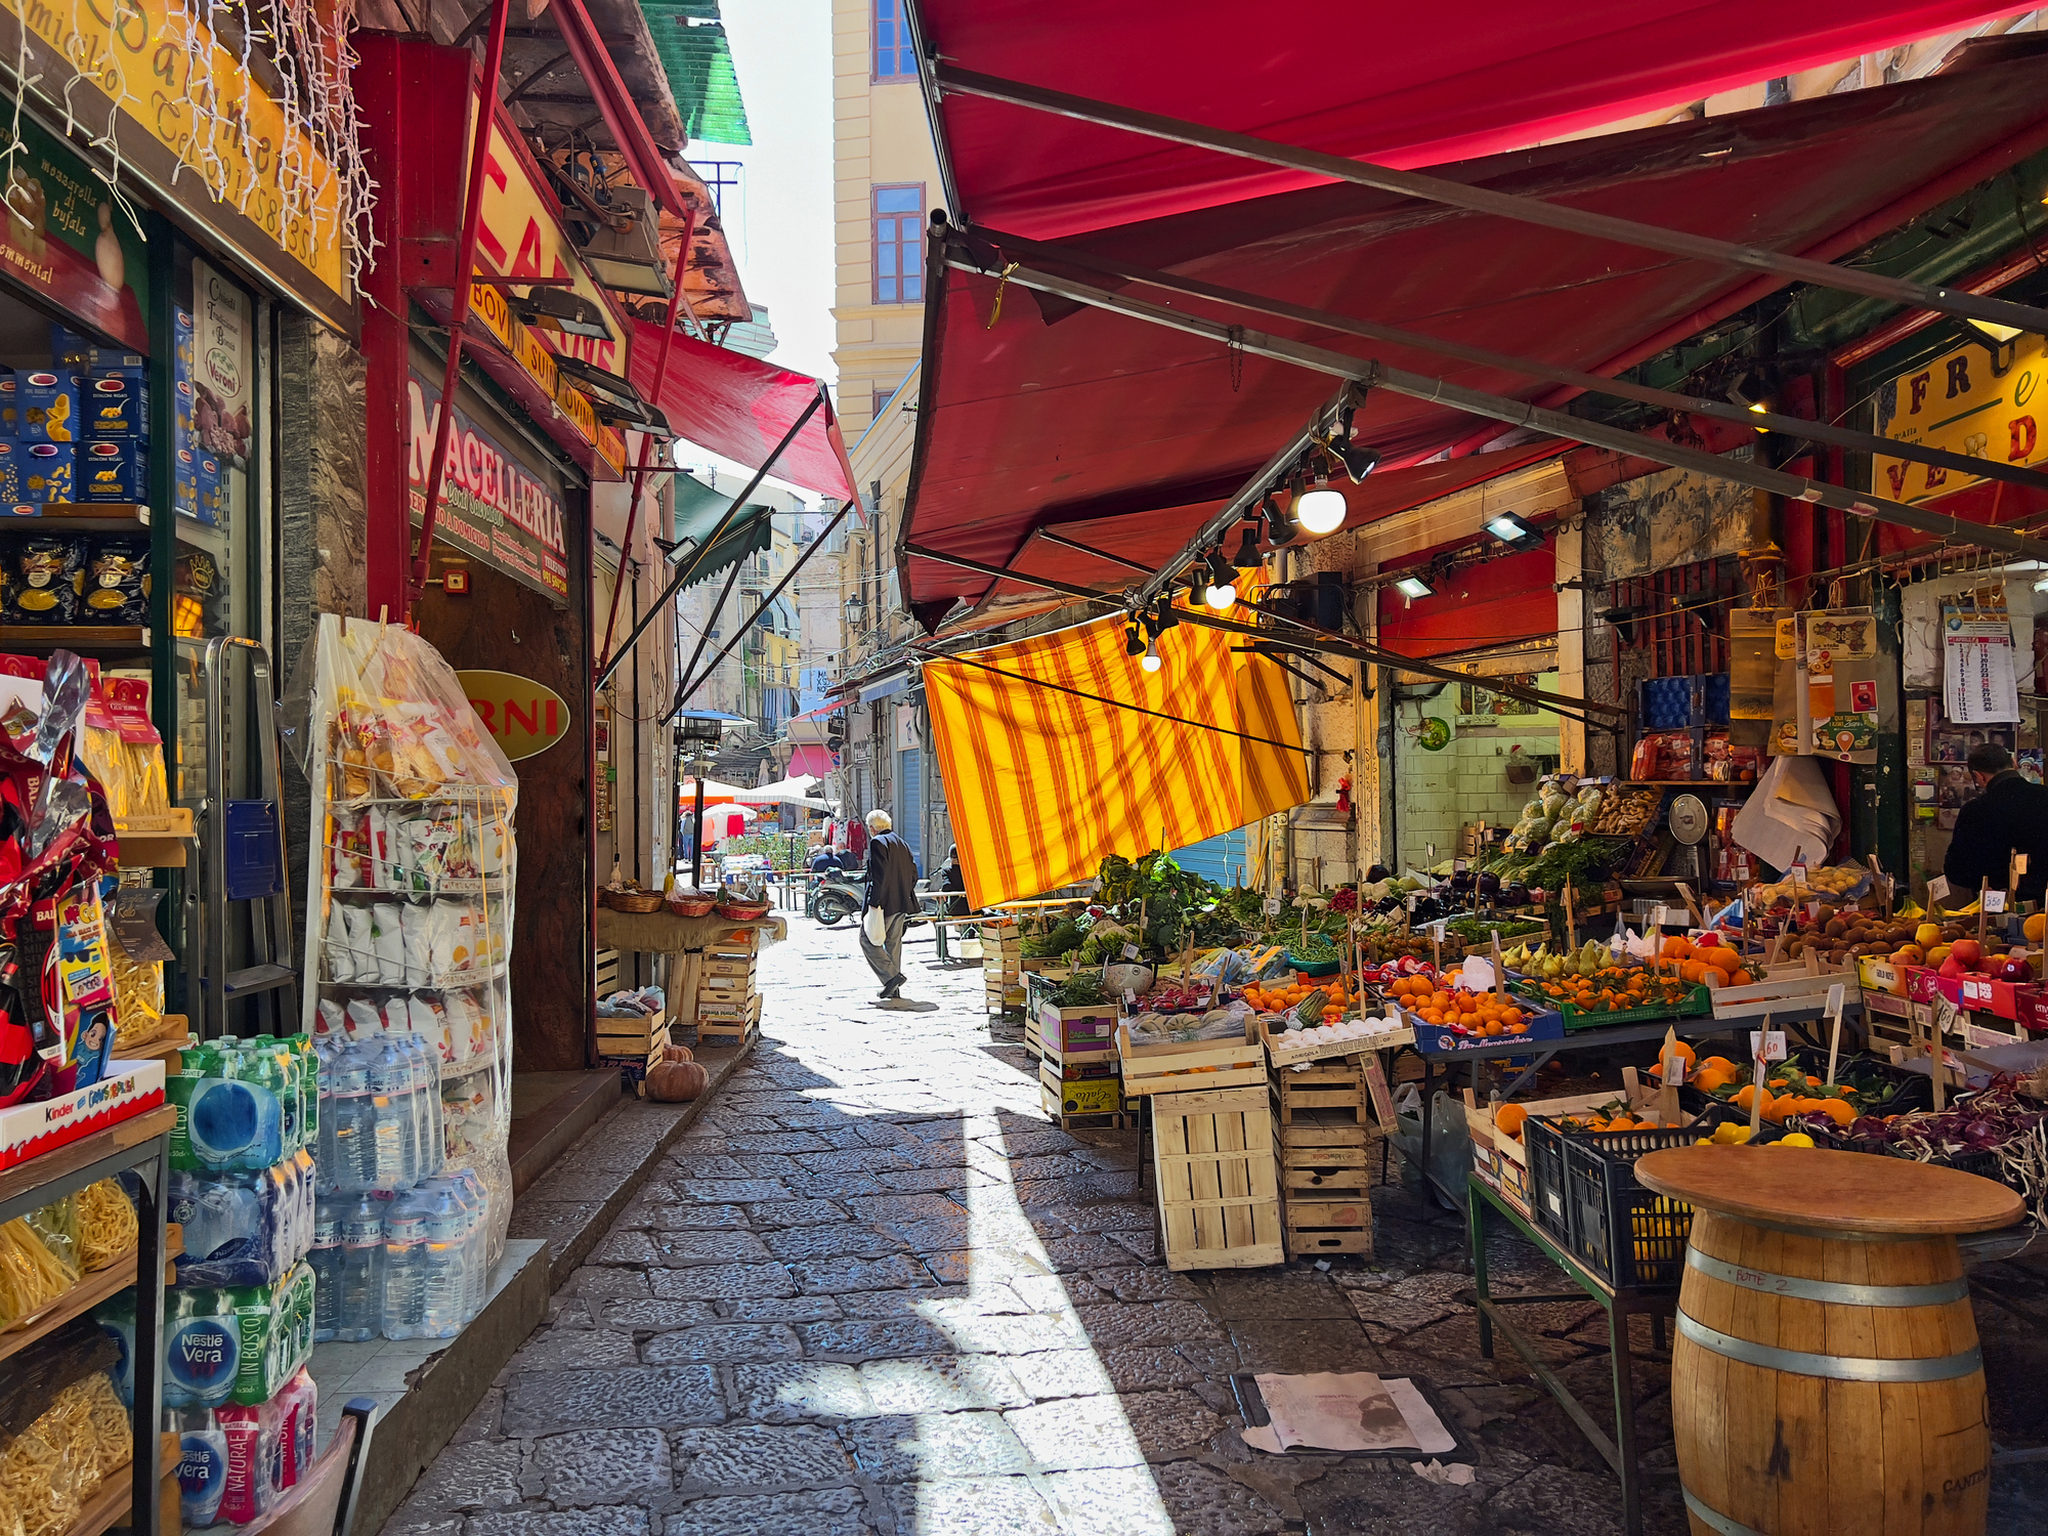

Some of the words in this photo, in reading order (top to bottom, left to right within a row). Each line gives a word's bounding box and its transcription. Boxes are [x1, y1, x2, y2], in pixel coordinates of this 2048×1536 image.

[41, 159, 98, 208] mozzarella
[64, 192, 75, 211] di
[52, 202, 87, 237] bufala
[209, 360, 236, 393] Veroni
[2014, 371, 2040, 407] e
[565, 387, 593, 436] OVINI
[408, 377, 566, 558] MACELLERIA
[1290, 1050, 1319, 1060] AGRICOLA
[46, 1103, 75, 1123] Kinder
[1736, 1269, 1767, 1286] BOTTE
[1775, 1279, 1792, 1291] 2
[181, 1348, 224, 1363] Vera
[241, 1317, 261, 1360] BOSCO
